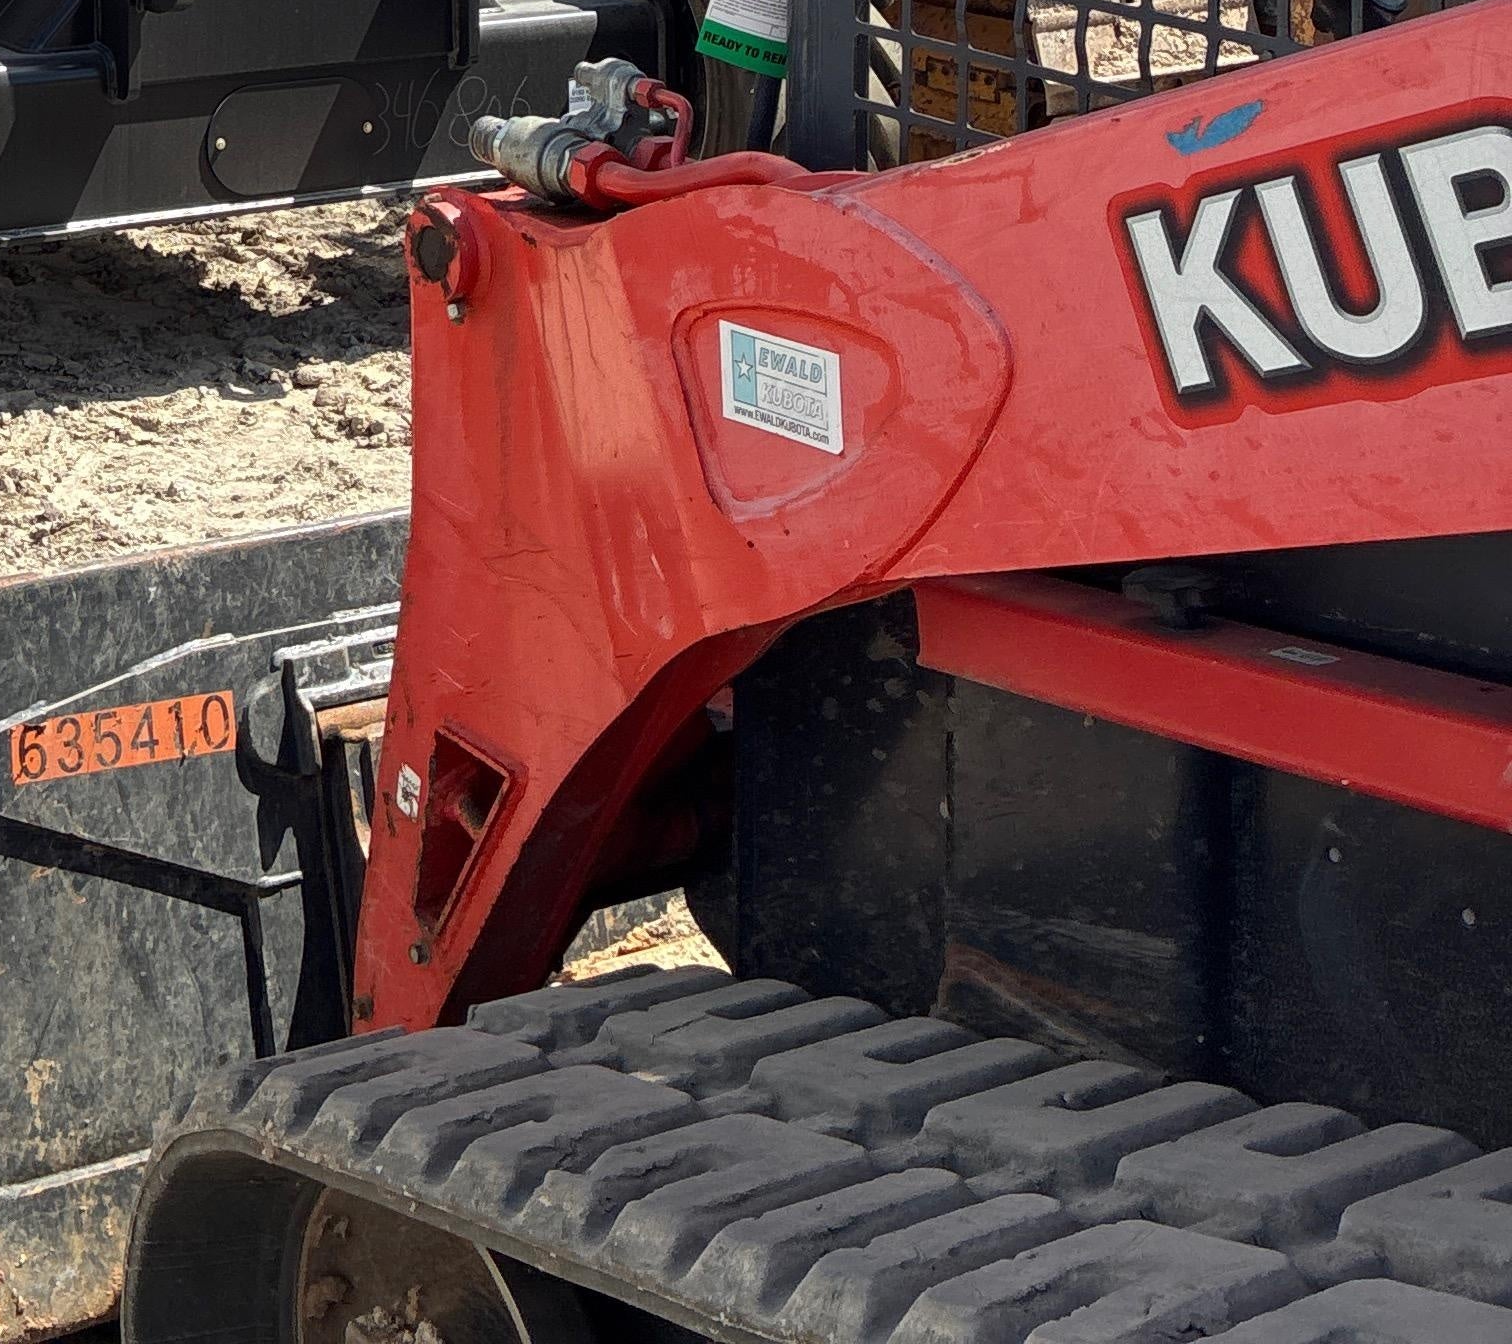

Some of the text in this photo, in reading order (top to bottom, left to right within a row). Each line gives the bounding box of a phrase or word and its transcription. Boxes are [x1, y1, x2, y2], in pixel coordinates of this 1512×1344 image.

[703, 30, 787, 66] READY TO REN
[1125, 124, 1512, 395] KUB
[757, 346, 823, 384] EWALD
[760, 381, 825, 422] KUBOTA
[733, 404, 830, 446] www.EWALDKUBOTA.com
[18, 693, 231, 780] 635410
